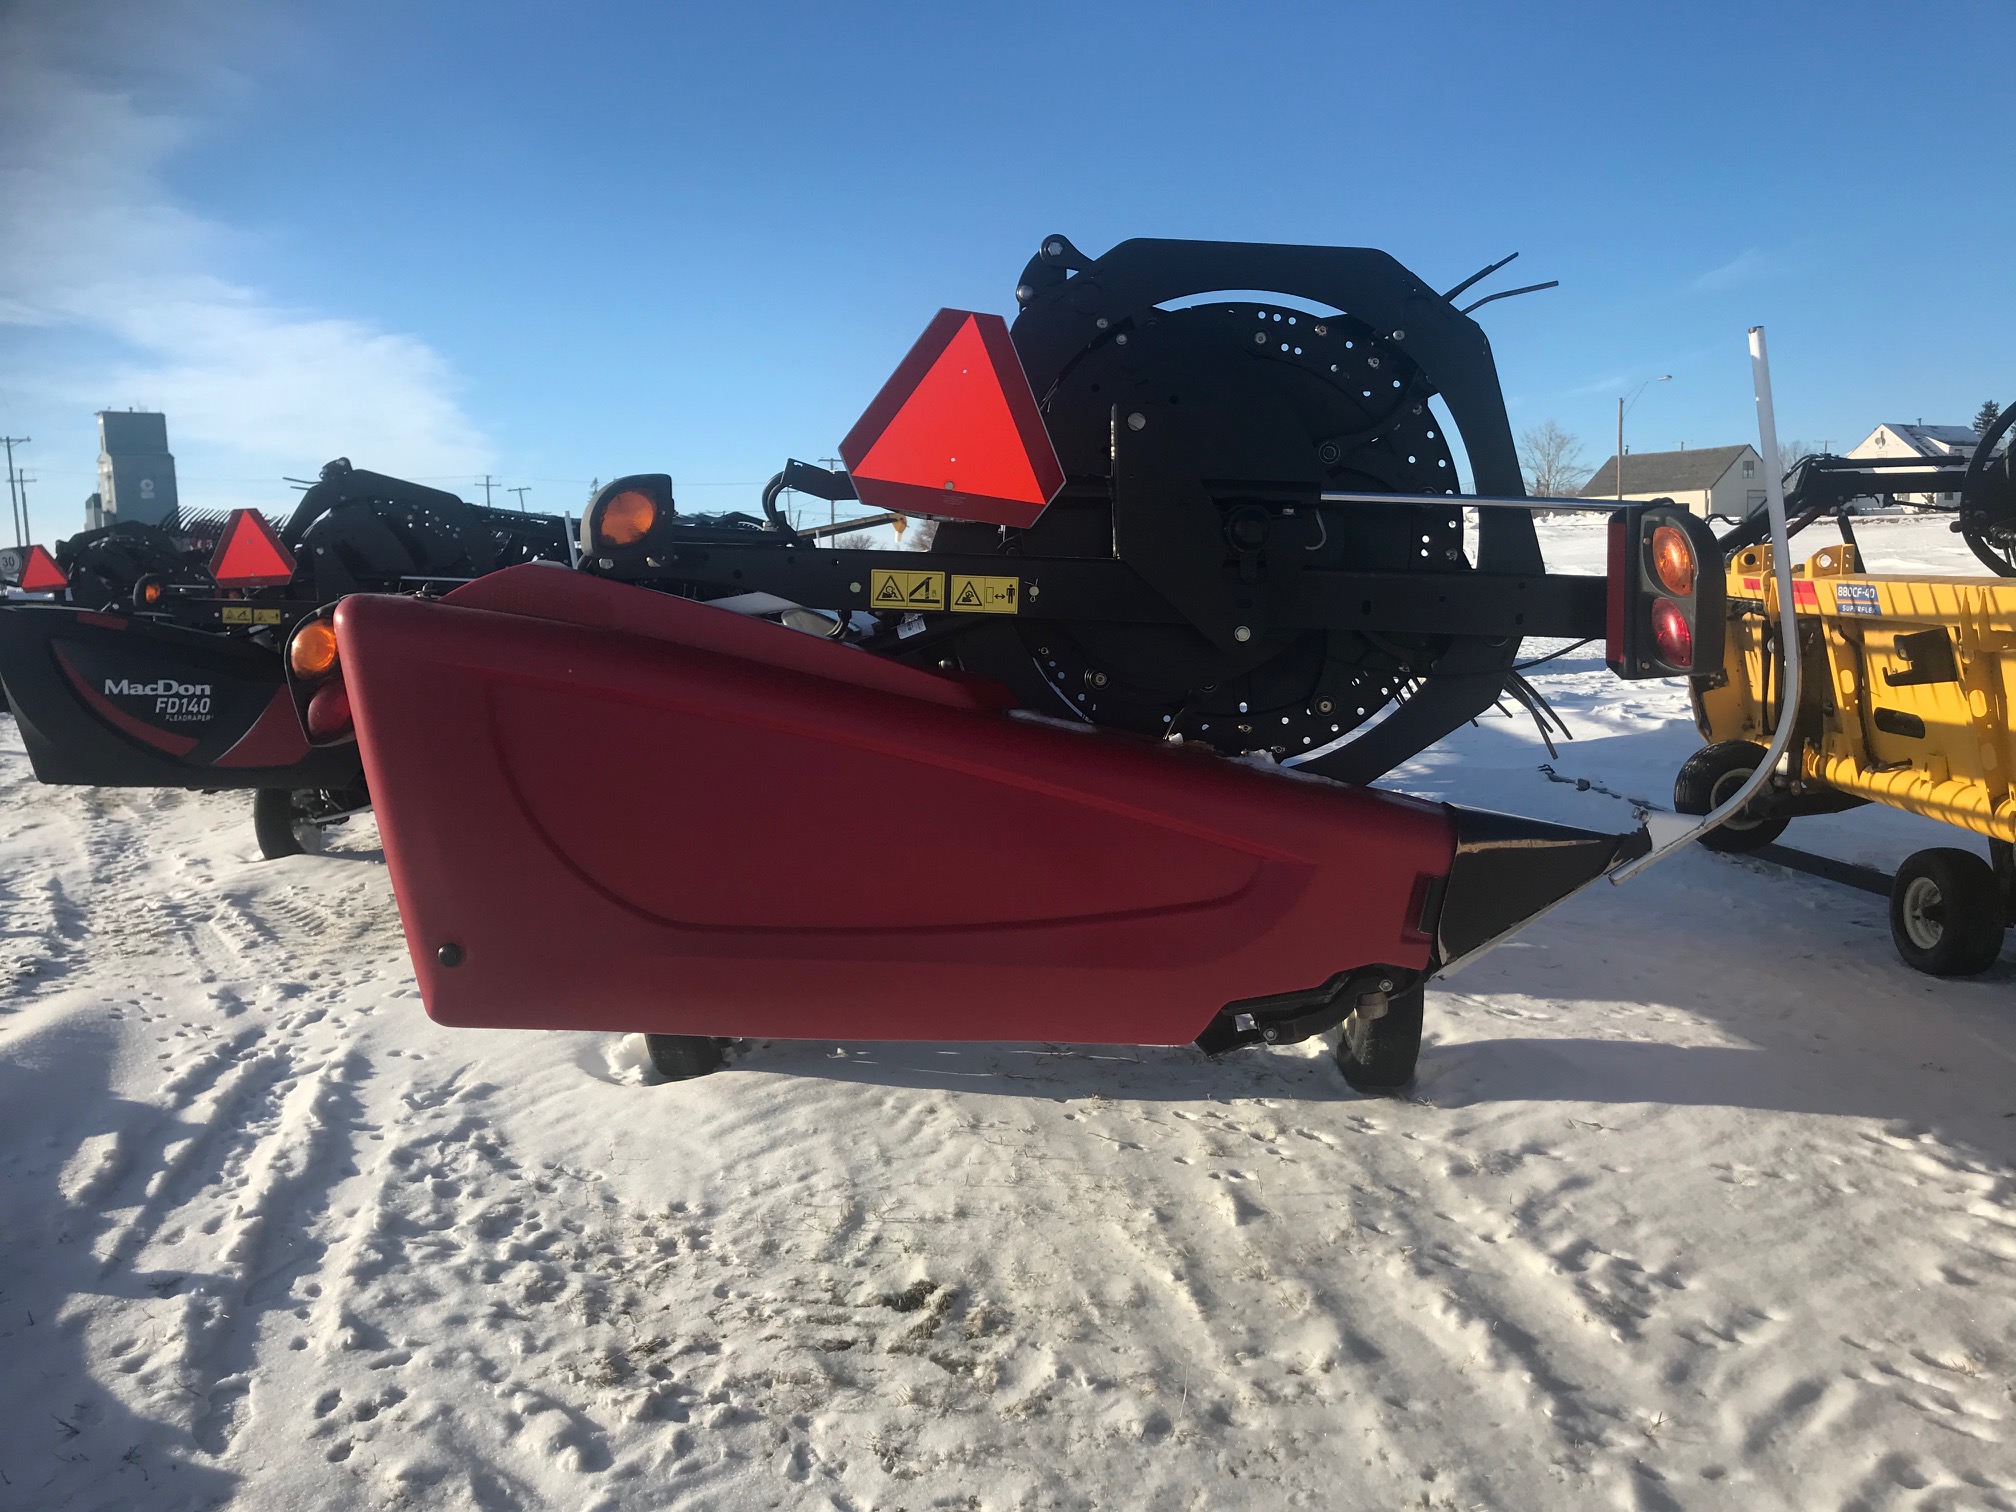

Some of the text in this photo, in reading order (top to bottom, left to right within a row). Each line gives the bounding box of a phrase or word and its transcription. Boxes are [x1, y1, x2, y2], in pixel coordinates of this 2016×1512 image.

[2, 556, 15, 567] 30
[1837, 586, 1875, 598] 880CF-40
[104, 679, 211, 695] MacDon
[155, 698, 211, 714] FD140
